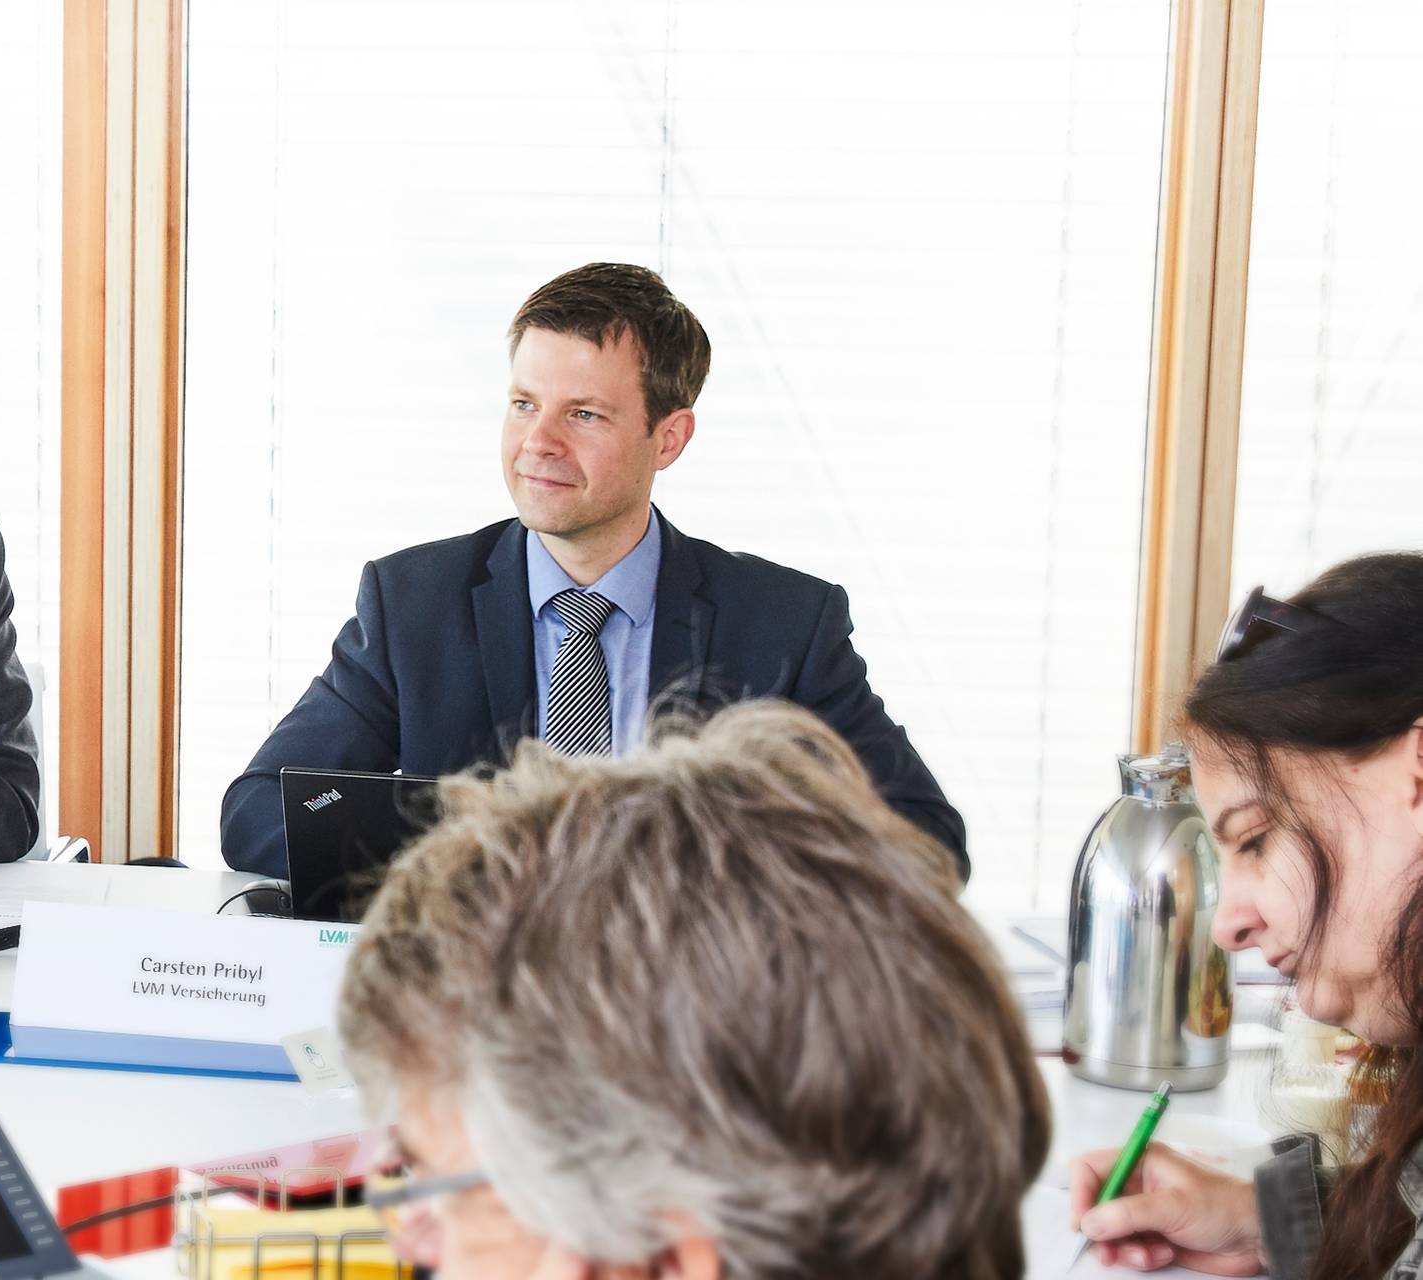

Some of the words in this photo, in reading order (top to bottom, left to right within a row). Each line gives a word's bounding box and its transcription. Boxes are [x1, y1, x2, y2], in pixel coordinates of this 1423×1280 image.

[302, 788, 343, 812] ThinkPad
[319, 929, 349, 944] LVM
[141, 957, 207, 977] Carsten
[213, 962, 263, 984] Pribyl
[132, 981, 165, 996] LVM
[171, 984, 266, 1008] Versicherung
